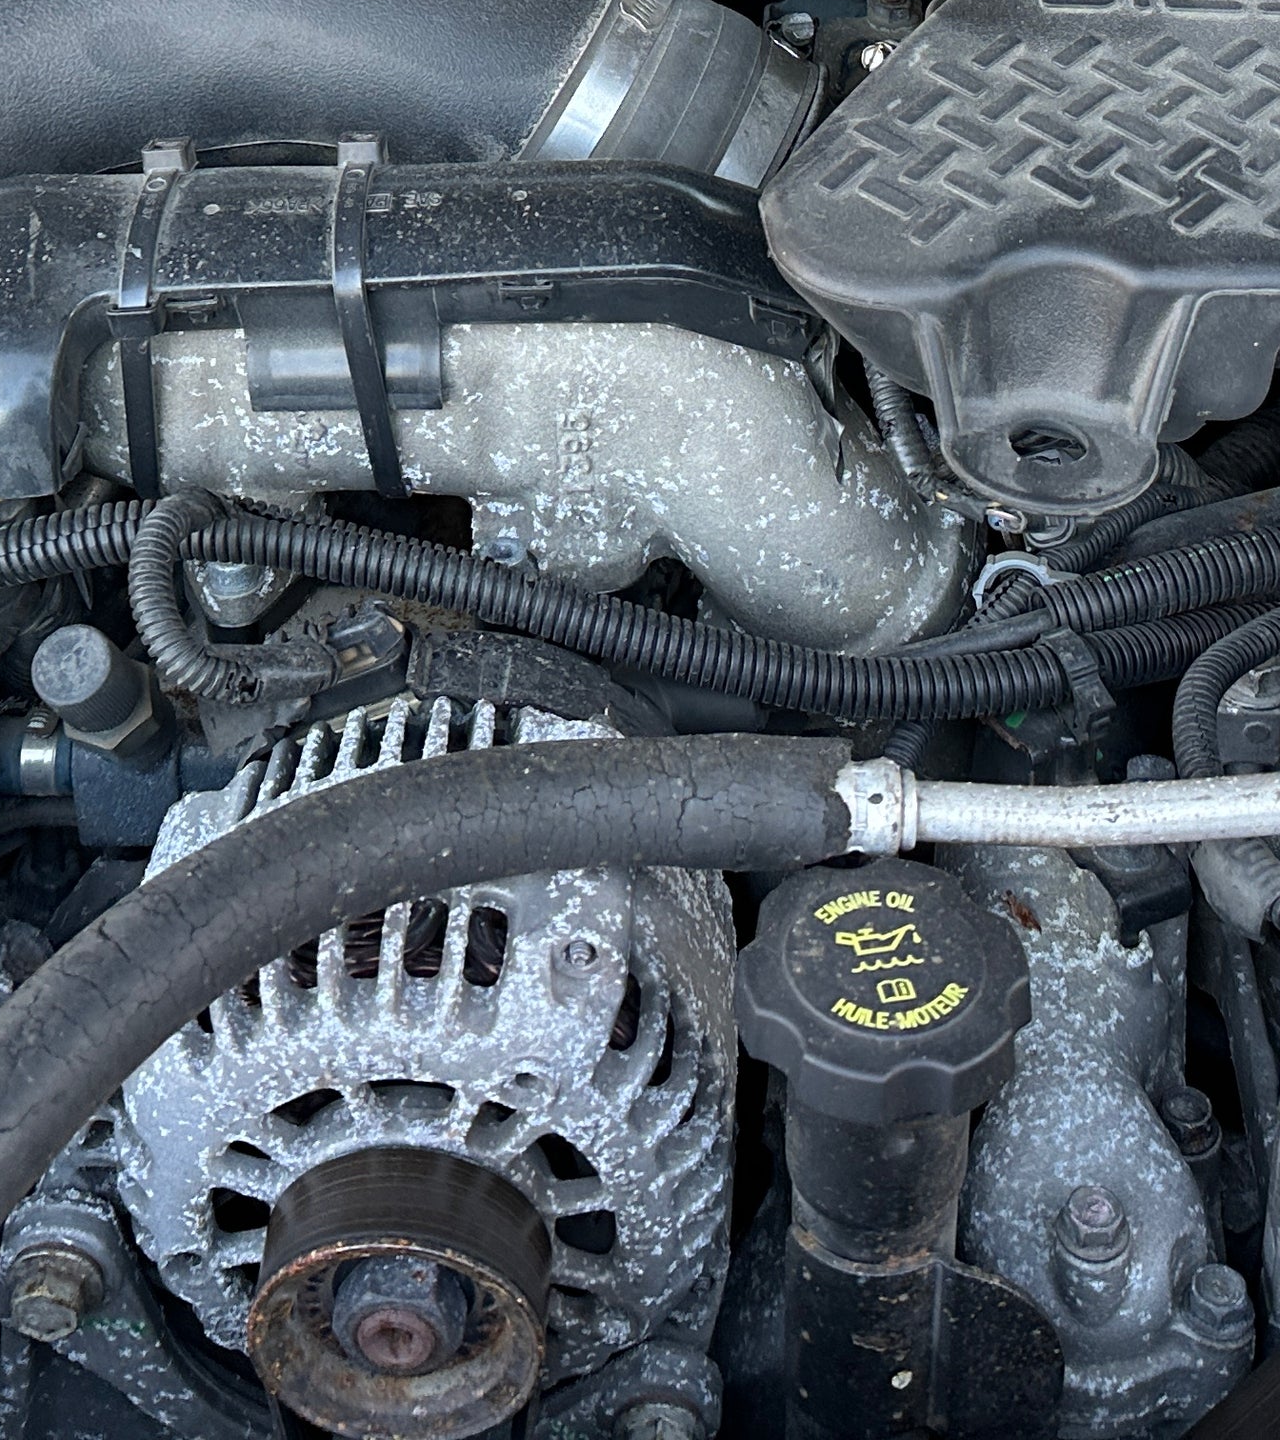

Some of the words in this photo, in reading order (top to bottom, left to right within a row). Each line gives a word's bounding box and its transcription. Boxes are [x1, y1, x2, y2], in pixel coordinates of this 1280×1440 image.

[813, 889, 883, 926] ENGINE
[884, 889, 916, 914] OIL
[830, 980, 970, 1031] HUILE-MOTEUR
